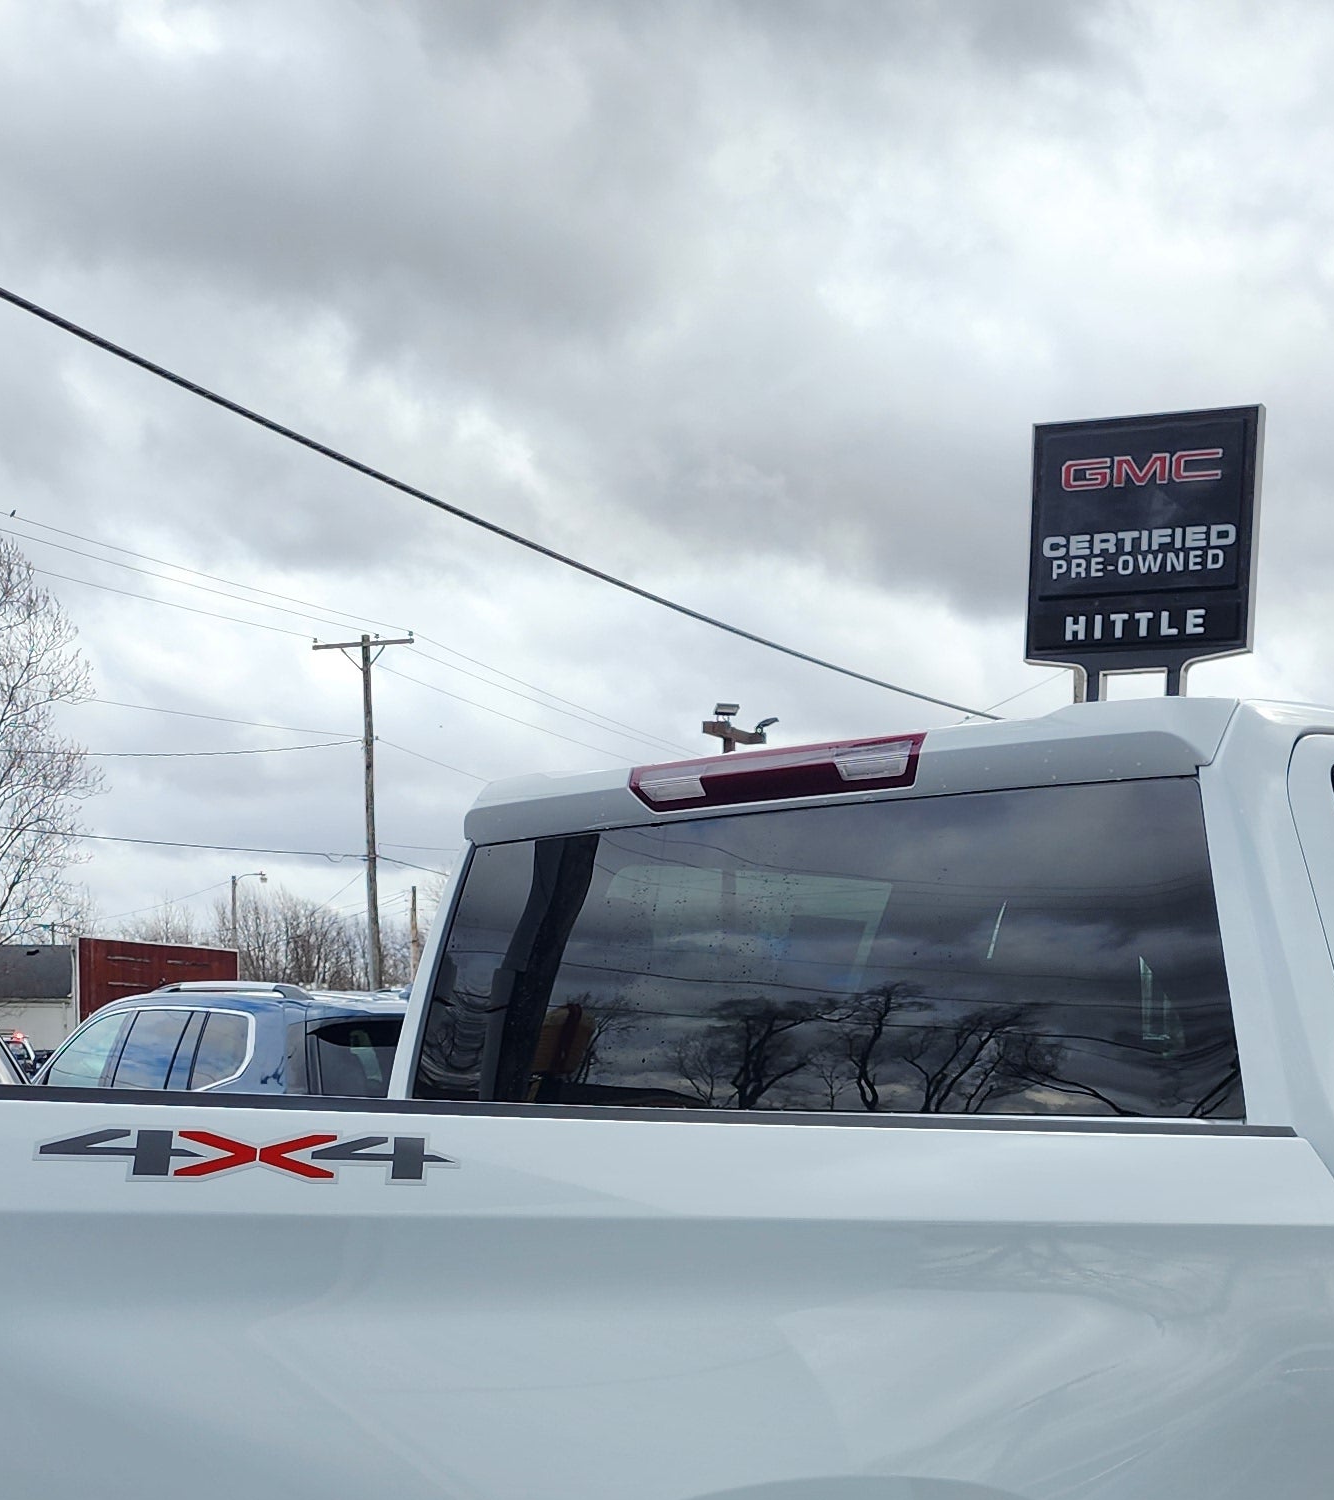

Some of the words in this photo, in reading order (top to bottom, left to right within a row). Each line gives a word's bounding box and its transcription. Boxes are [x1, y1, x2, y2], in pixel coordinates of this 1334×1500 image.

[1061, 448, 1223, 492] GMC
[1042, 523, 1237, 558] CERTIFIED
[1052, 549, 1224, 580] PRE-OWNED
[1065, 608, 1206, 641] HITTLE
